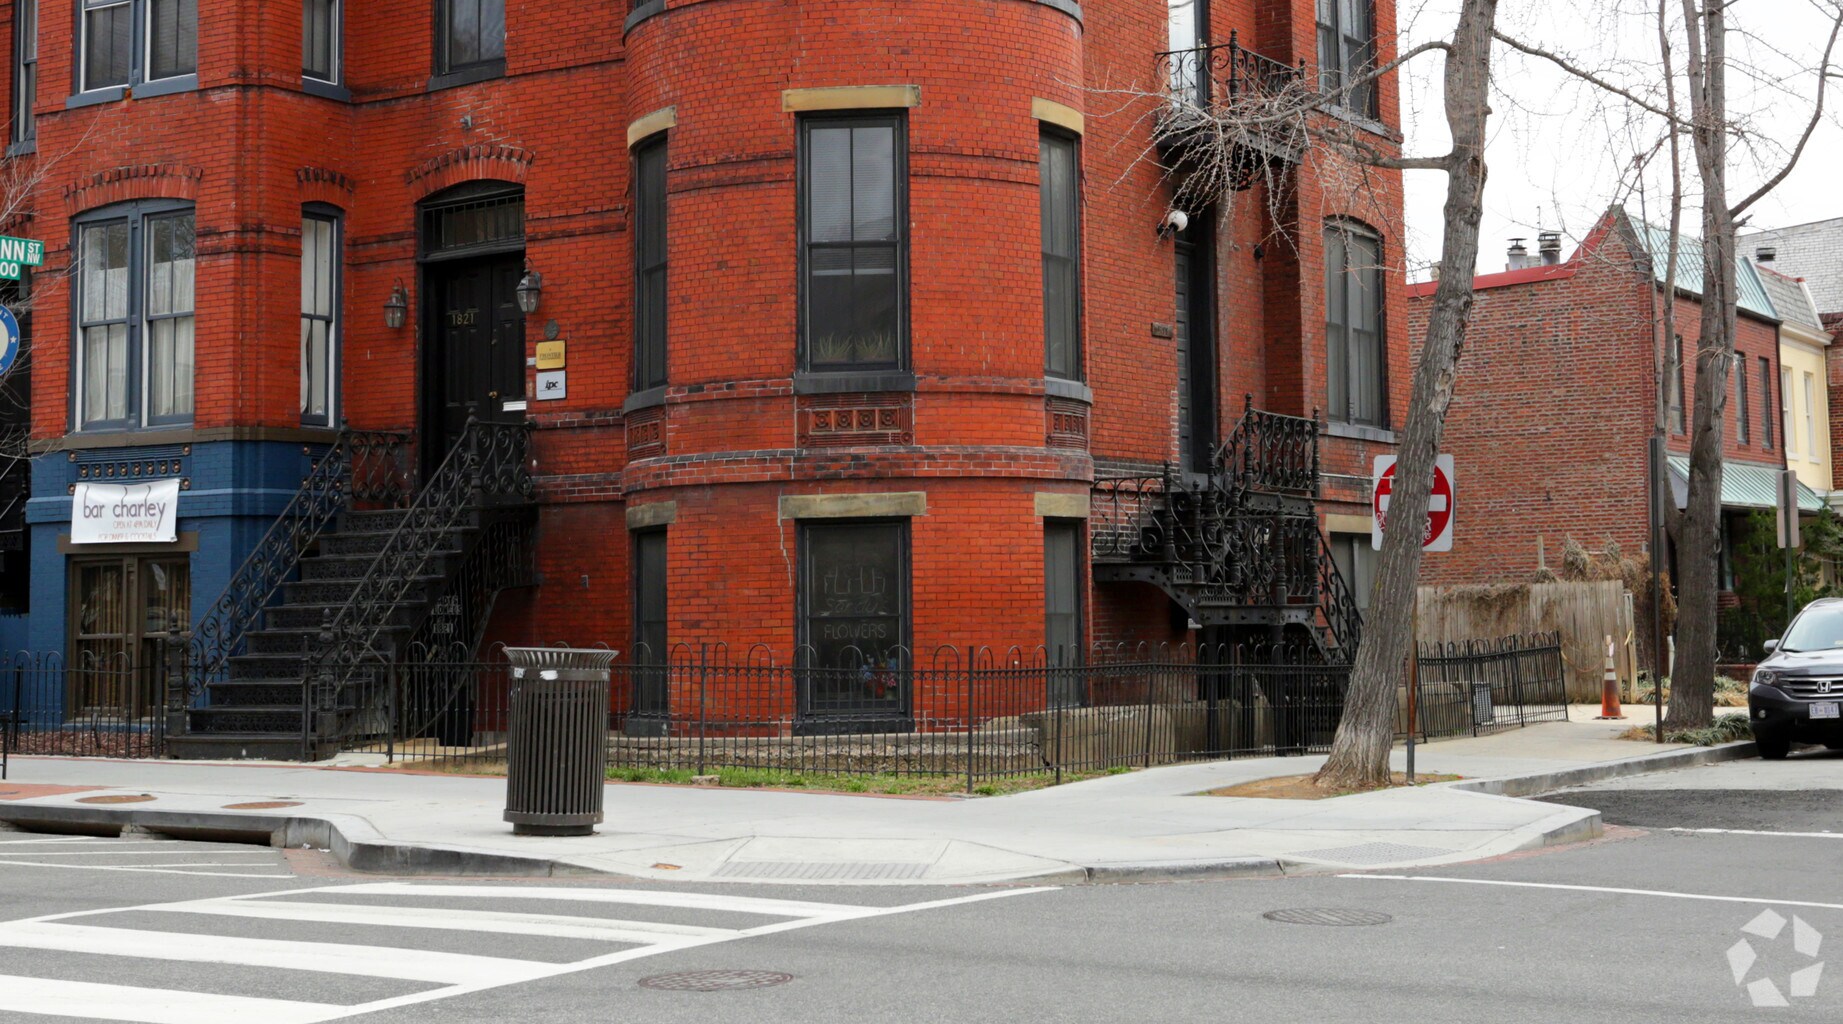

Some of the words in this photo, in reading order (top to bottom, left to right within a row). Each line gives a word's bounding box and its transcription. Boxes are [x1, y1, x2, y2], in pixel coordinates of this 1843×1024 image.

[28, 242, 41, 254] ST
[27, 253, 40, 264] NW
[452, 313, 474, 325] 1821
[83, 484, 105, 518] bar
[112, 484, 166, 531] charley
[824, 623, 887, 640] FLOWERS
